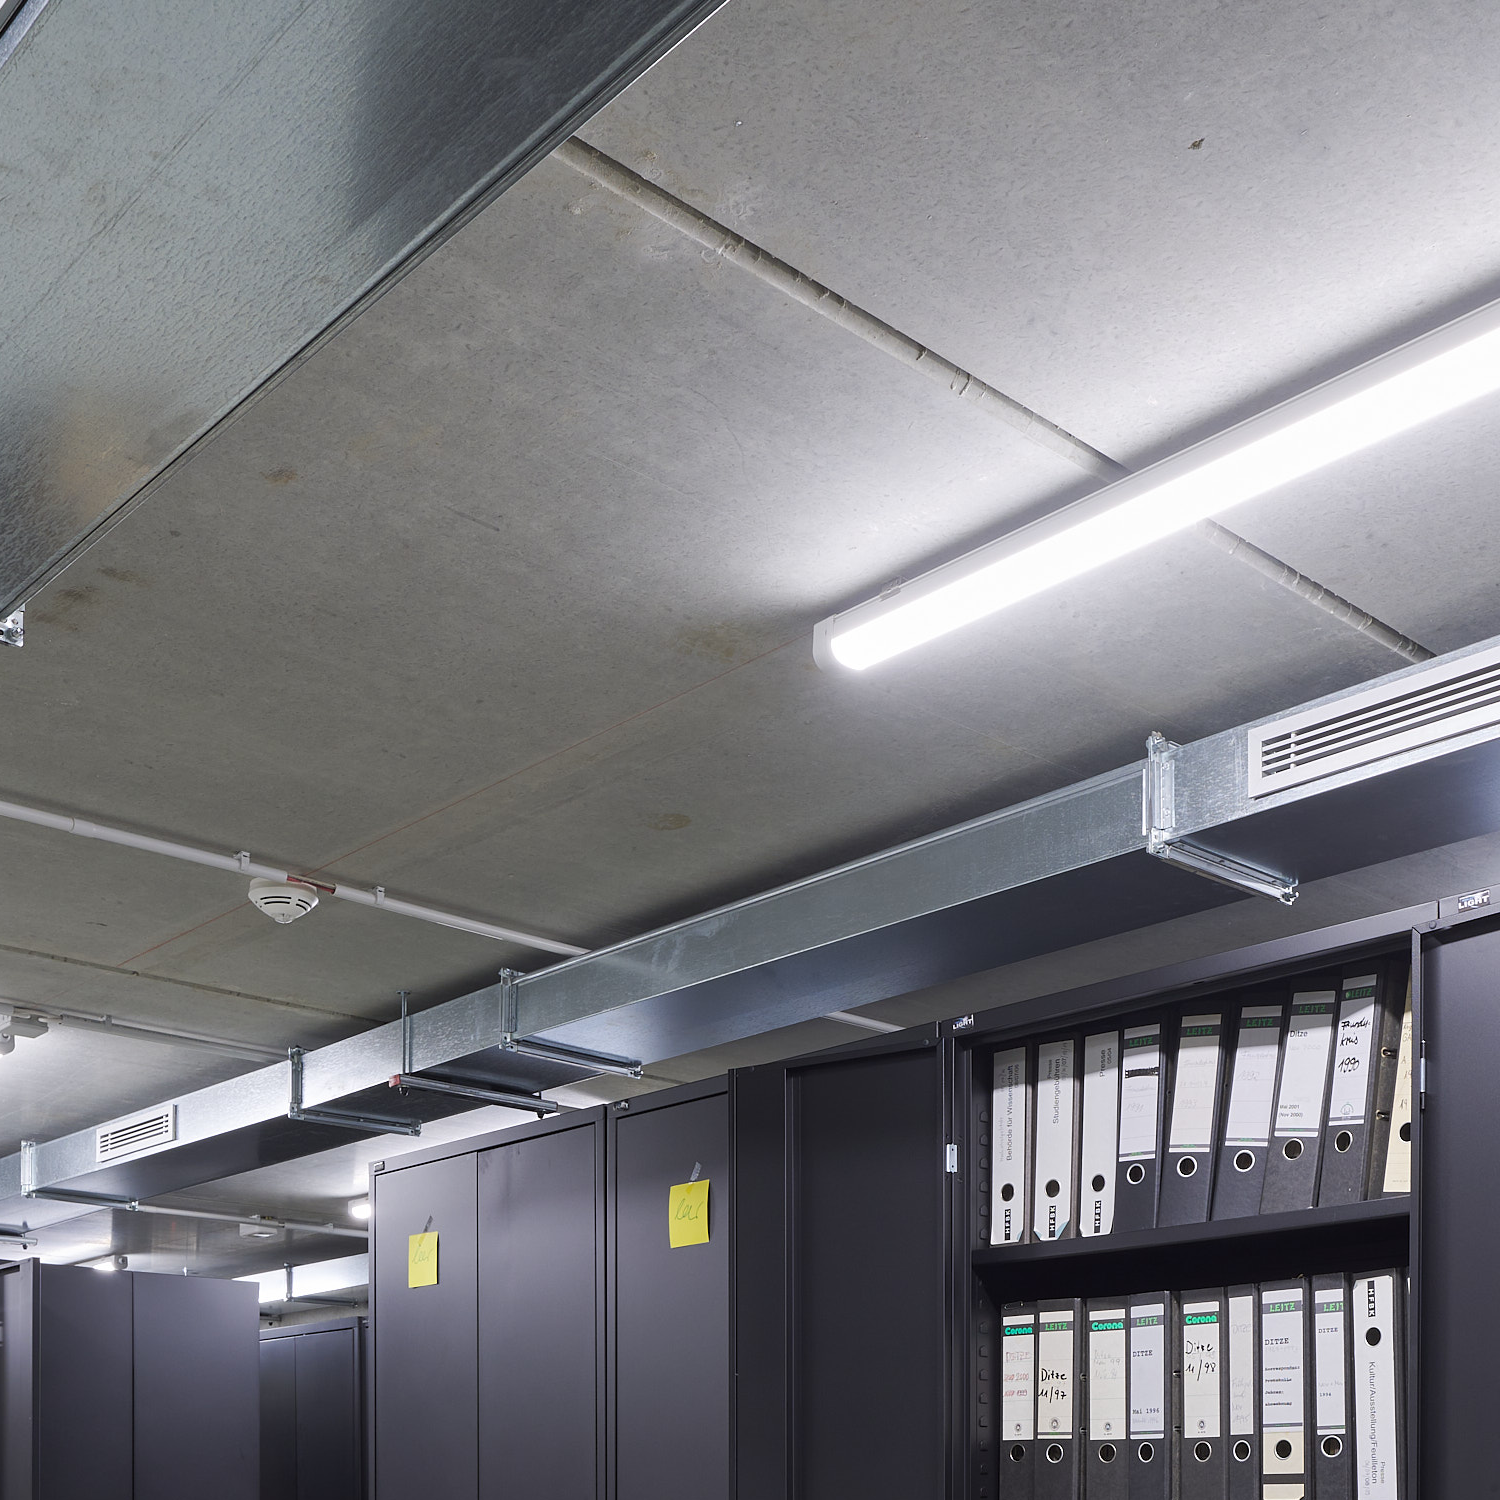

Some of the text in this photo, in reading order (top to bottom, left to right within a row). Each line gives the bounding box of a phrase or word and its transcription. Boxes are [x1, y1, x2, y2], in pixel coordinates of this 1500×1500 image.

[1459, 893, 1490, 909] LIGHT
[1351, 988, 1372, 998] LEITZ
[1299, 1005, 1326, 1013] LEITZ
[952, 1016, 973, 1030] LIGHT
[1246, 1018, 1273, 1027] LEITZ
[1187, 1027, 1213, 1036] LEITZ
[1290, 1029, 1308, 1038] Ditze
[1129, 1038, 1153, 1047] LEITZ
[1270, 1302, 1295, 1312] LEITZ
[1136, 1317, 1158, 1326] LEITZ
[1186, 1314, 1217, 1324] Corona
[1005, 1326, 1032, 1335] Corona
[1045, 1323, 1067, 1331] LEITZ
[1092, 1321, 1123, 1331] Corona
[1265, 1338, 1289, 1346] DITZE
[1132, 1350, 1153, 1358] DITZE
[1041, 1368, 1067, 1382] Ditze
[1369, 1361, 1377, 1484] Kultur/Ausstellung/Feuilleton
